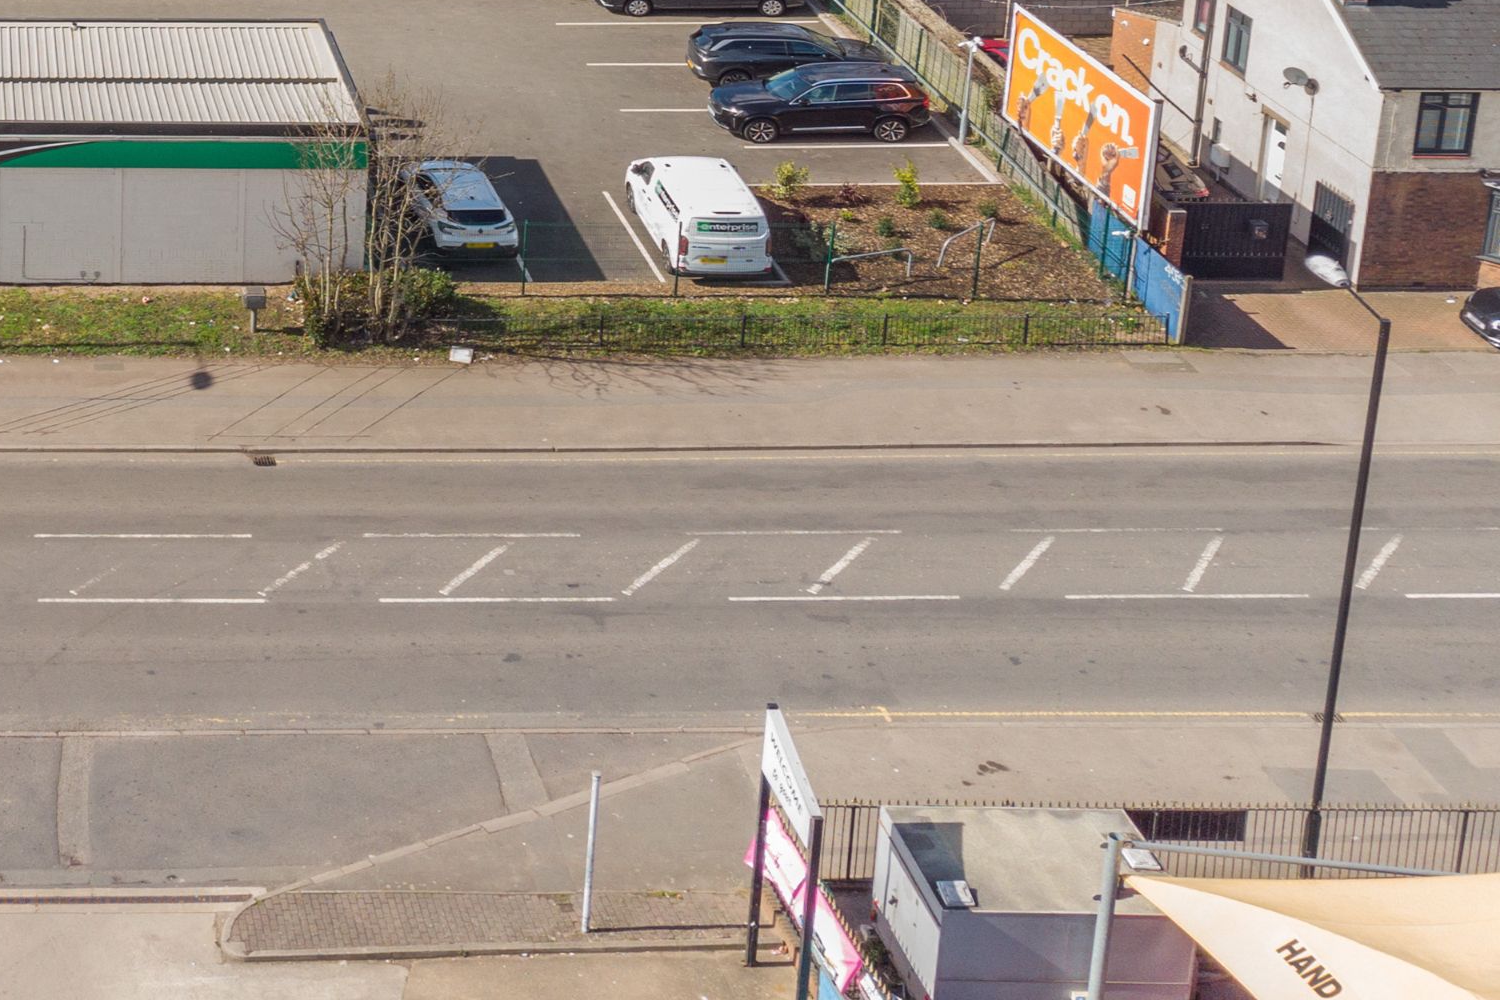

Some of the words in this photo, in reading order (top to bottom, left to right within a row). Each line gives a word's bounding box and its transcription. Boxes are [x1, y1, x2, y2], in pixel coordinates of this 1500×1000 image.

[1017, 27, 1095, 112] Crack
[1094, 93, 1134, 146] on.
[699, 223, 758, 232] enterprise
[1275, 938, 1343, 999] HAND
